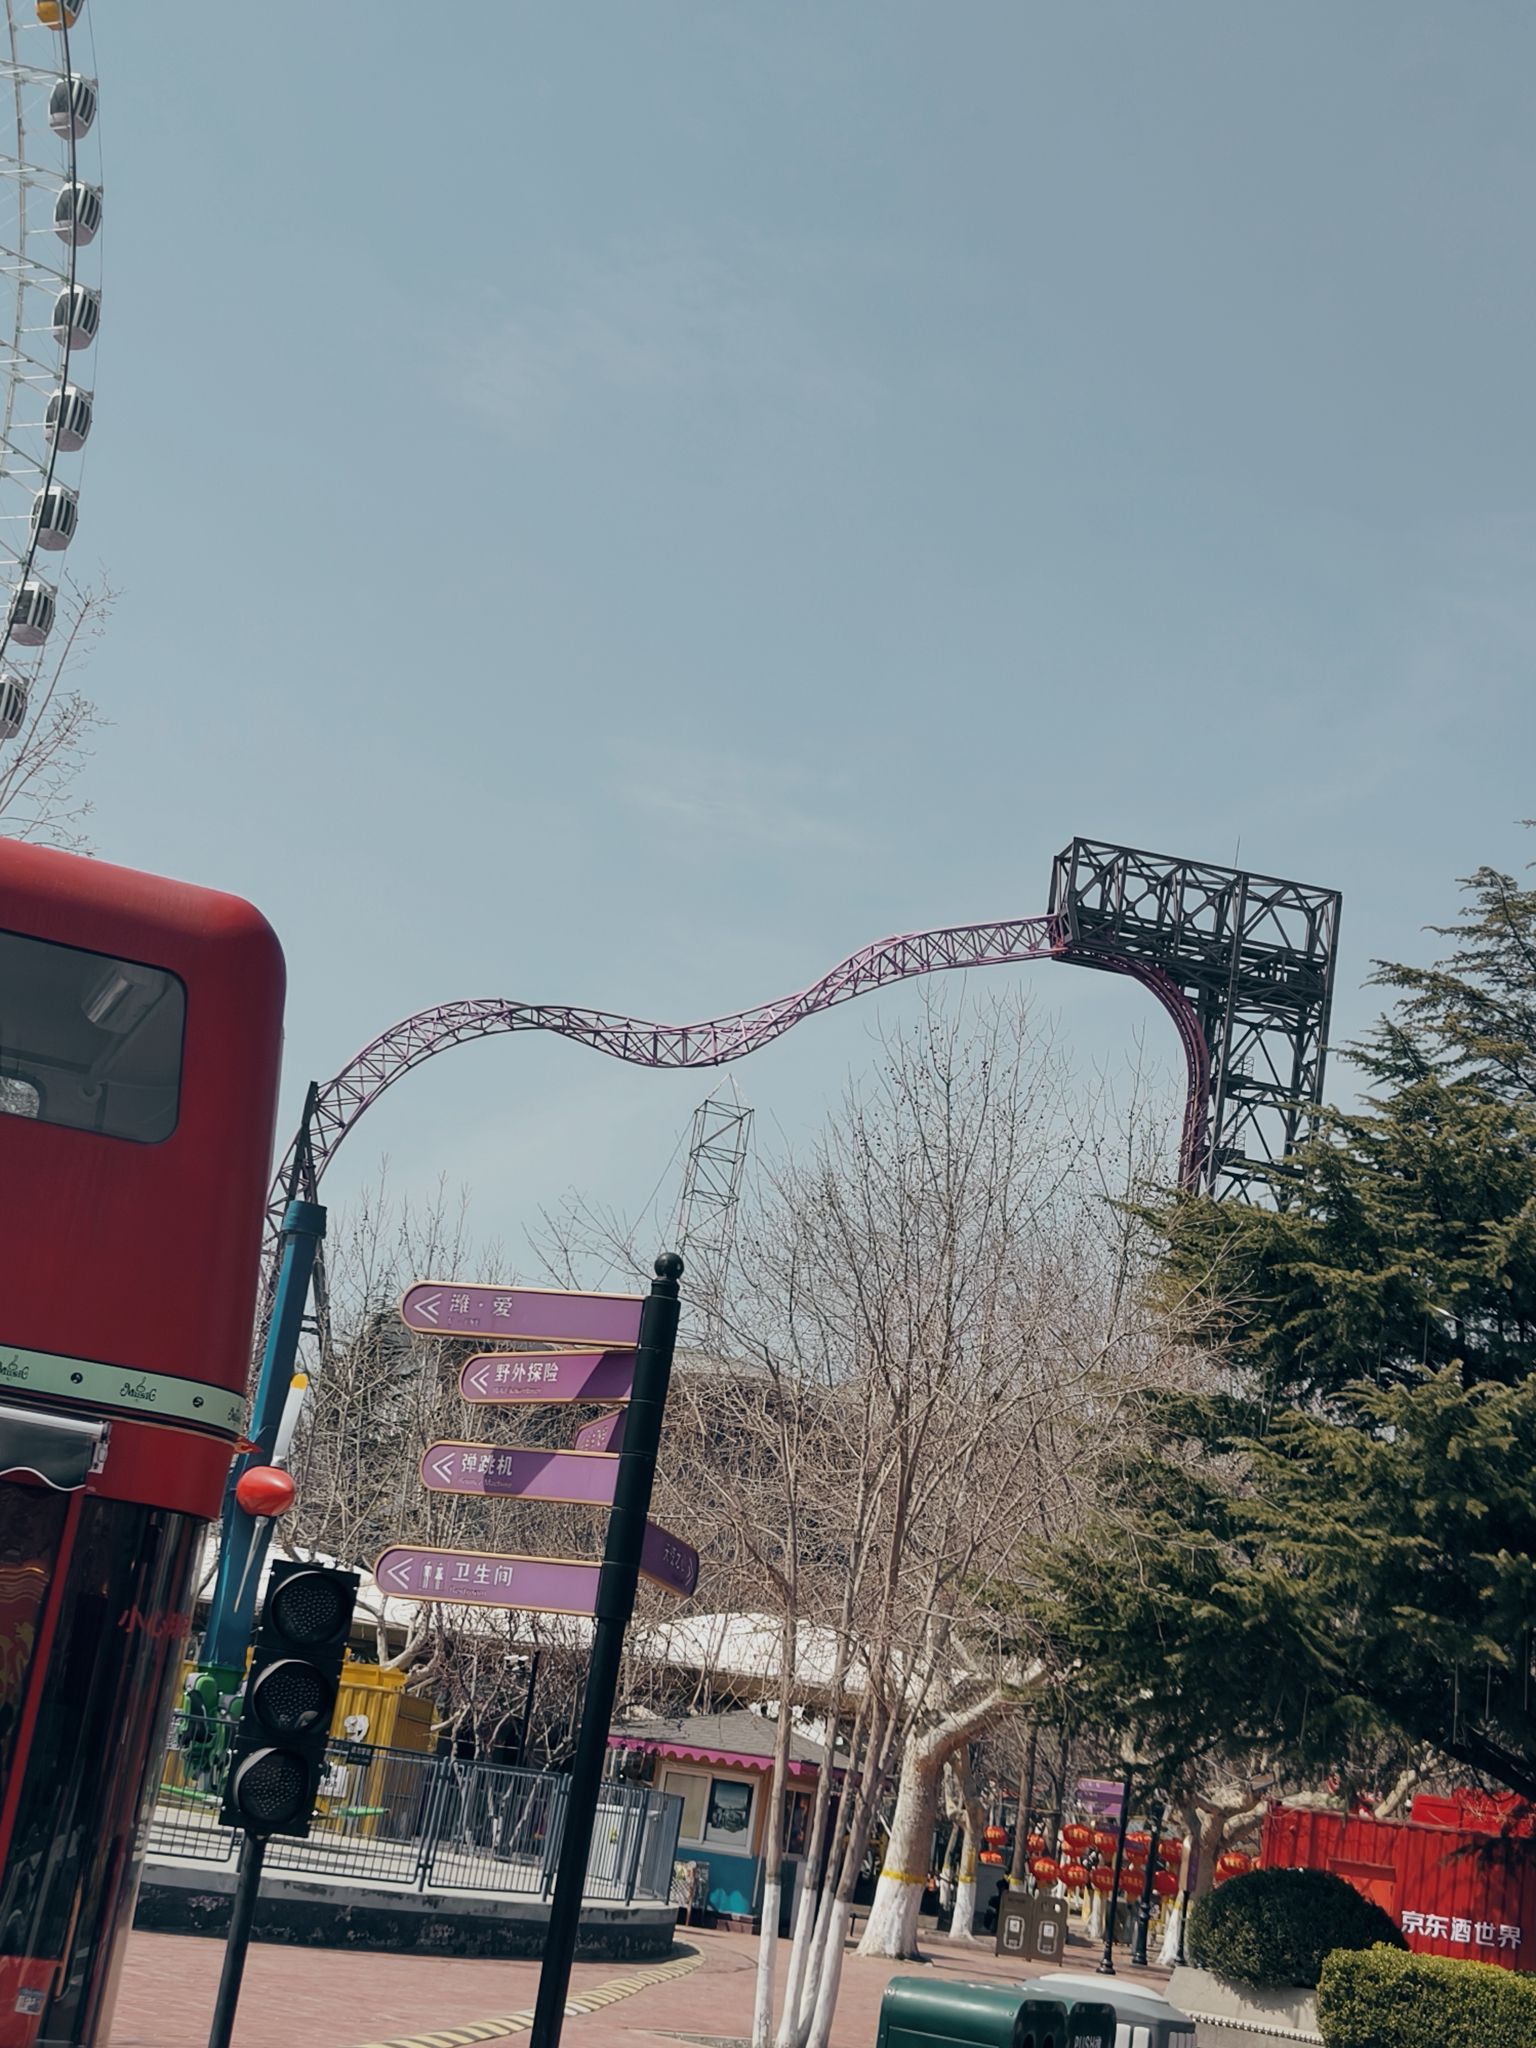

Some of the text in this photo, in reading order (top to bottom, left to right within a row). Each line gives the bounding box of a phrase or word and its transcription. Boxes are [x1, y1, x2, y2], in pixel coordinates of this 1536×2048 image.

[494, 1362, 559, 1383] 野外探险
[461, 1453, 513, 1476] 弹跳机
[452, 1562, 513, 1587] 卫生间
[1401, 1910, 1521, 1950] 京东酒世界
